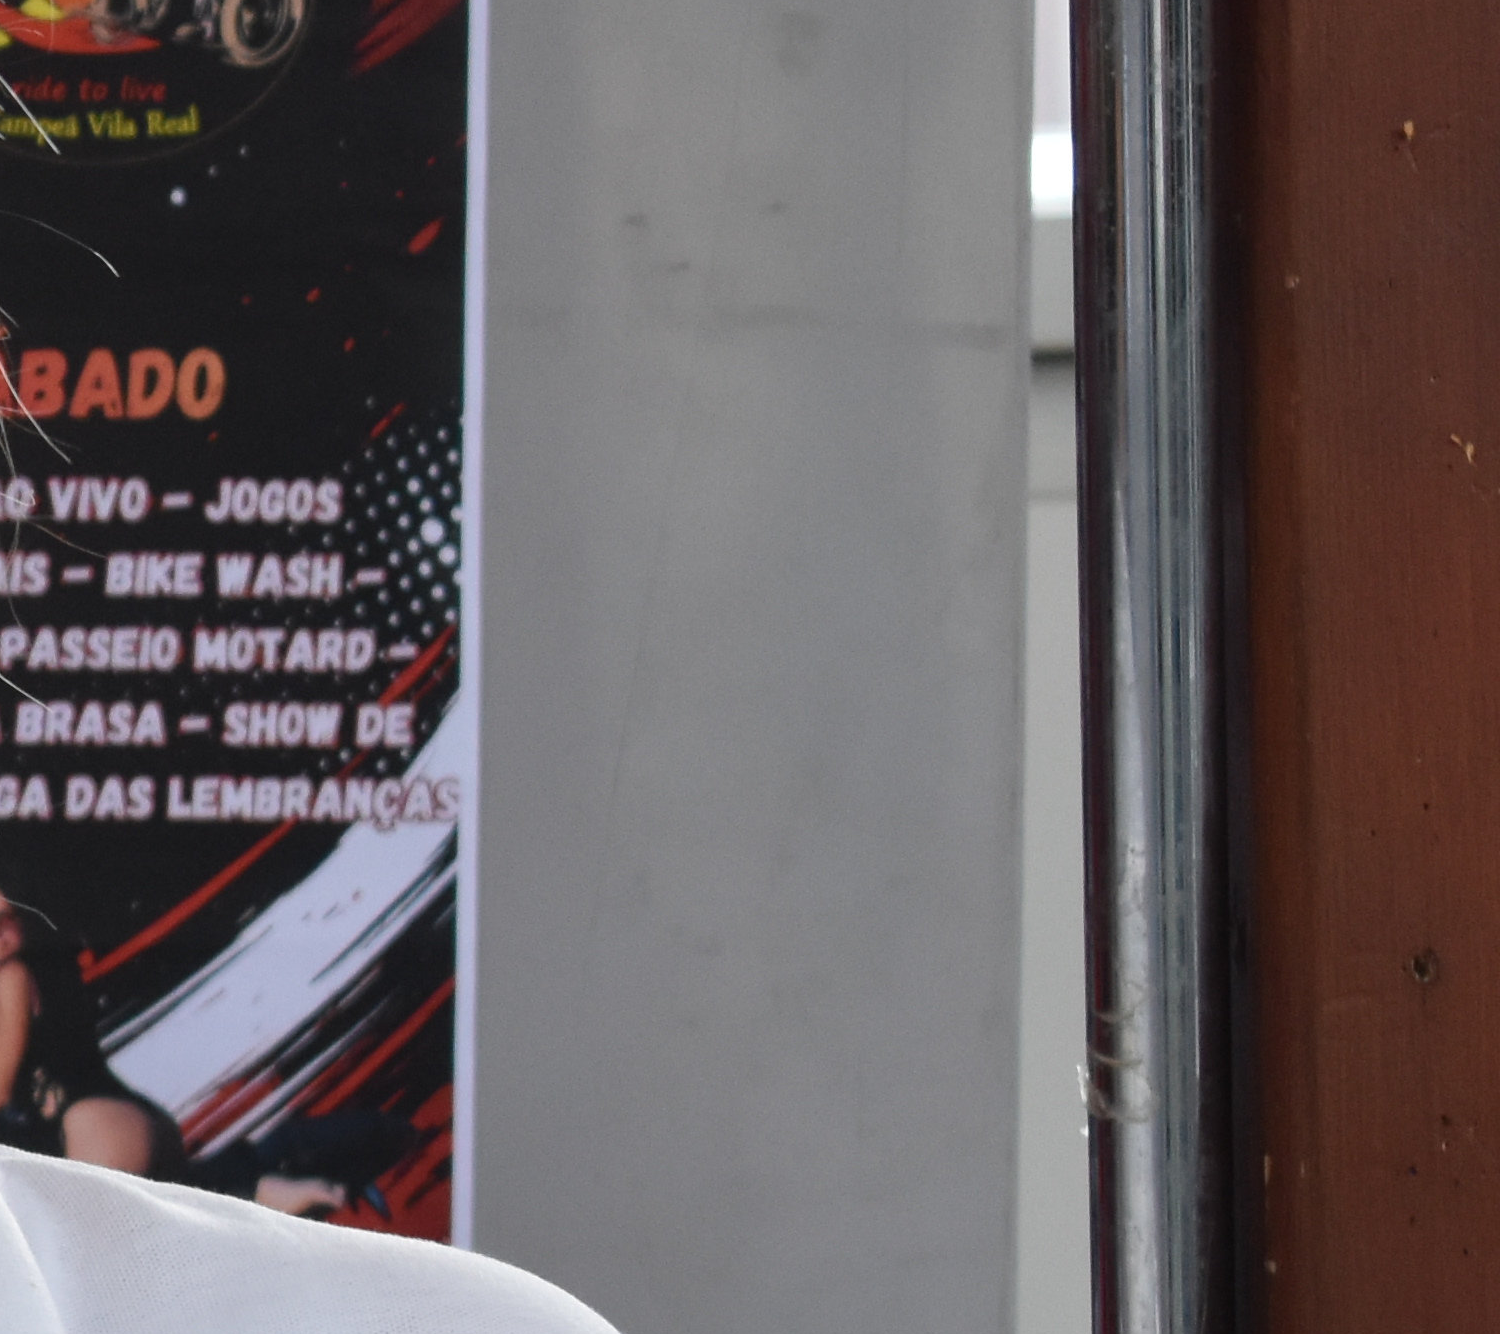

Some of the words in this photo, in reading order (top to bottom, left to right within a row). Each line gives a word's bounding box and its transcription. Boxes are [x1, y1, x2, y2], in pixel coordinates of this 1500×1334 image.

[13, 75, 67, 102] ride
[80, 77, 108, 102] to
[120, 74, 167, 103] live
[87, 109, 137, 138] Vila
[147, 103, 199, 136] Real
[47, 477, 150, 522] VIVO
[205, 478, 344, 523] JOGOS
[104, 553, 204, 598] BIKE
[216, 552, 344, 599] WASH
[193, 626, 376, 673] MOTARD
[15, 699, 167, 745] BRASA
[222, 700, 343, 748] SHOW
[355, 702, 415, 748] DE
[65, 774, 156, 820] DAS
[166, 774, 461, 831] LEMBRANÇAS
